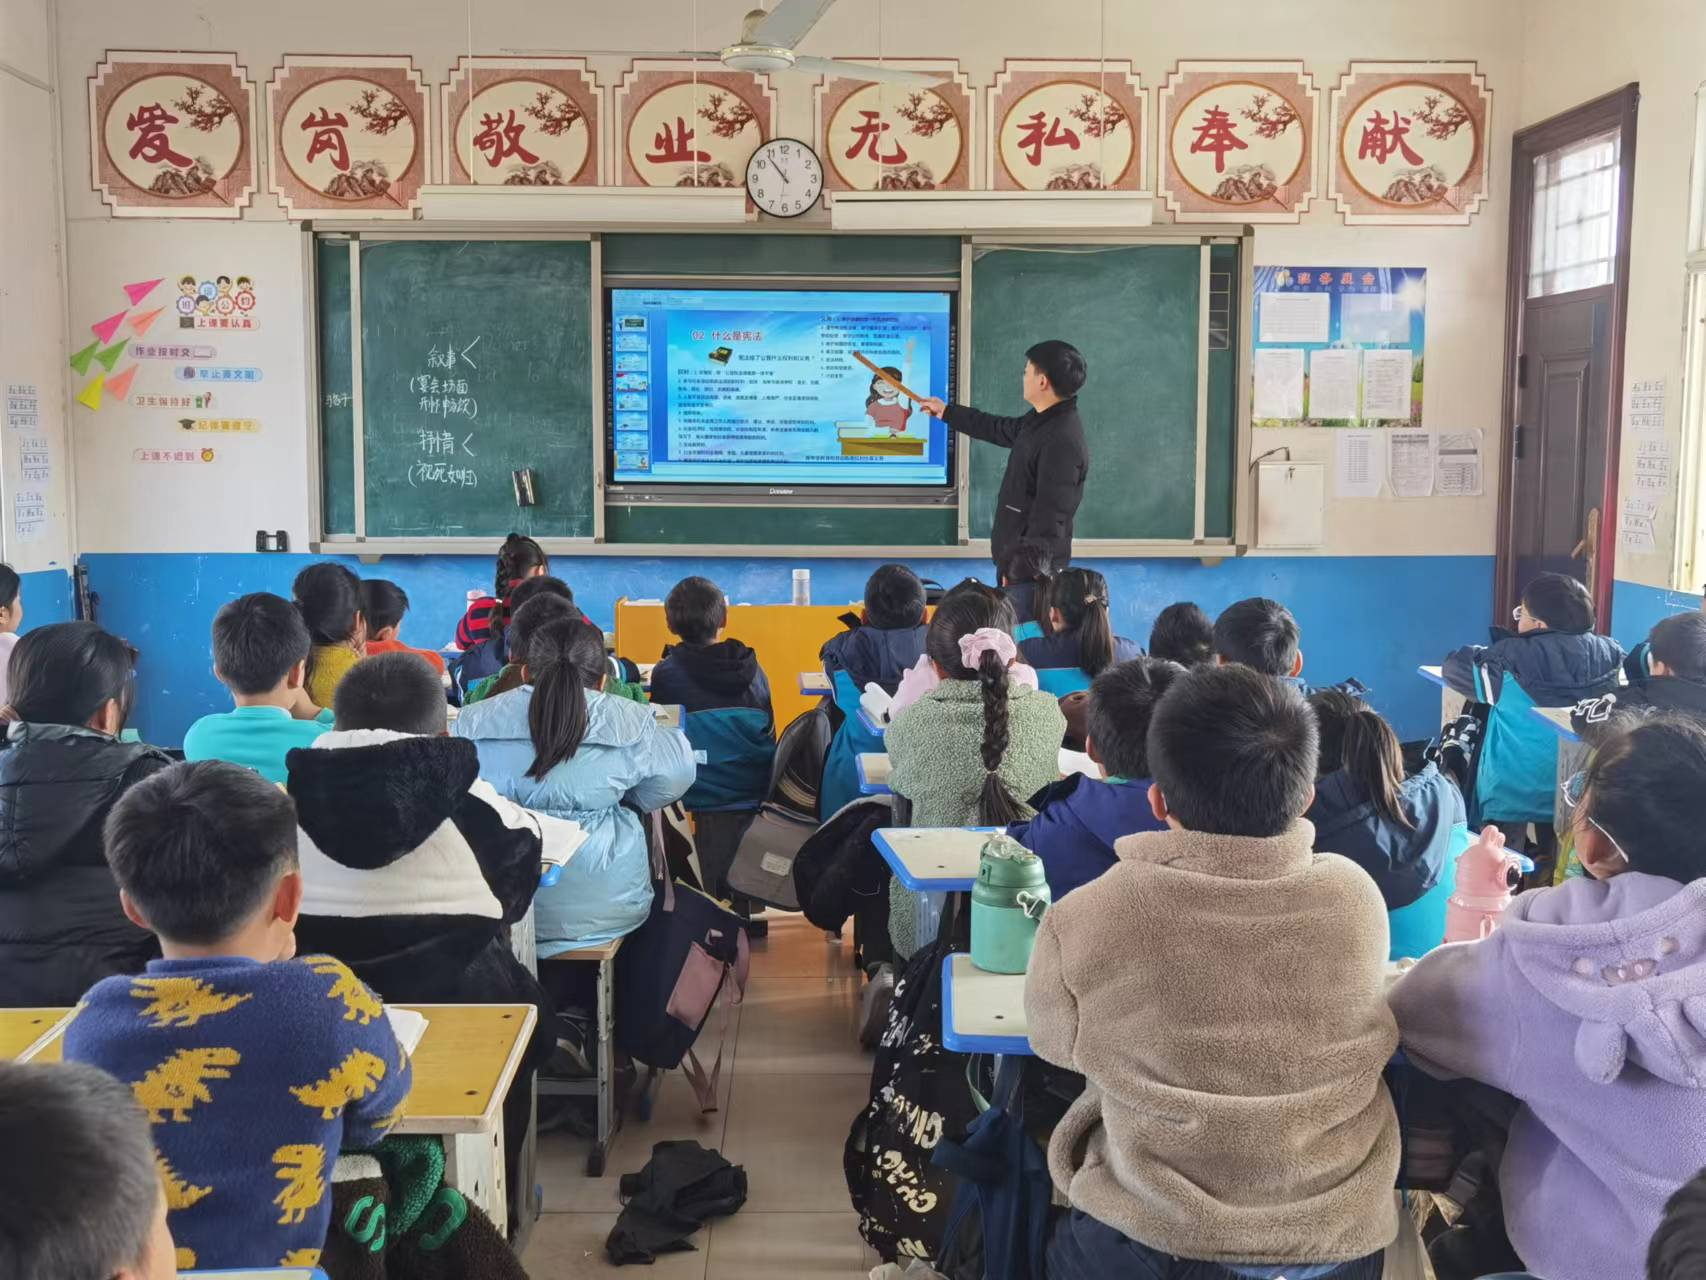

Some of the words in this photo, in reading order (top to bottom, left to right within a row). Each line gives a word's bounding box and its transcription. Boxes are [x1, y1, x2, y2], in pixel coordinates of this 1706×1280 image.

[767, 149, 775, 158] 11
[780, 145, 790, 155] 12
[757, 160, 766, 169] 10
[804, 160, 811, 169] 2
[752, 174, 759, 183] 9
[810, 174, 817, 183] 3
[757, 189, 764, 198] 8
[805, 189, 811, 199] 4
[768, 200, 775, 209] 7
[781, 203, 788, 212] 6
[795, 200, 801, 209] 5
[197, 319, 252, 329] 上课要认真
[712, 331, 762, 341] 什么是宪法
[136, 345, 190, 357] 作业按时交
[427, 344, 457, 369] 叙事
[136, 396, 191, 407] 卫生保持好
[419, 429, 454, 455] 抒情
[142, 450, 195, 461] 上课不迟到
